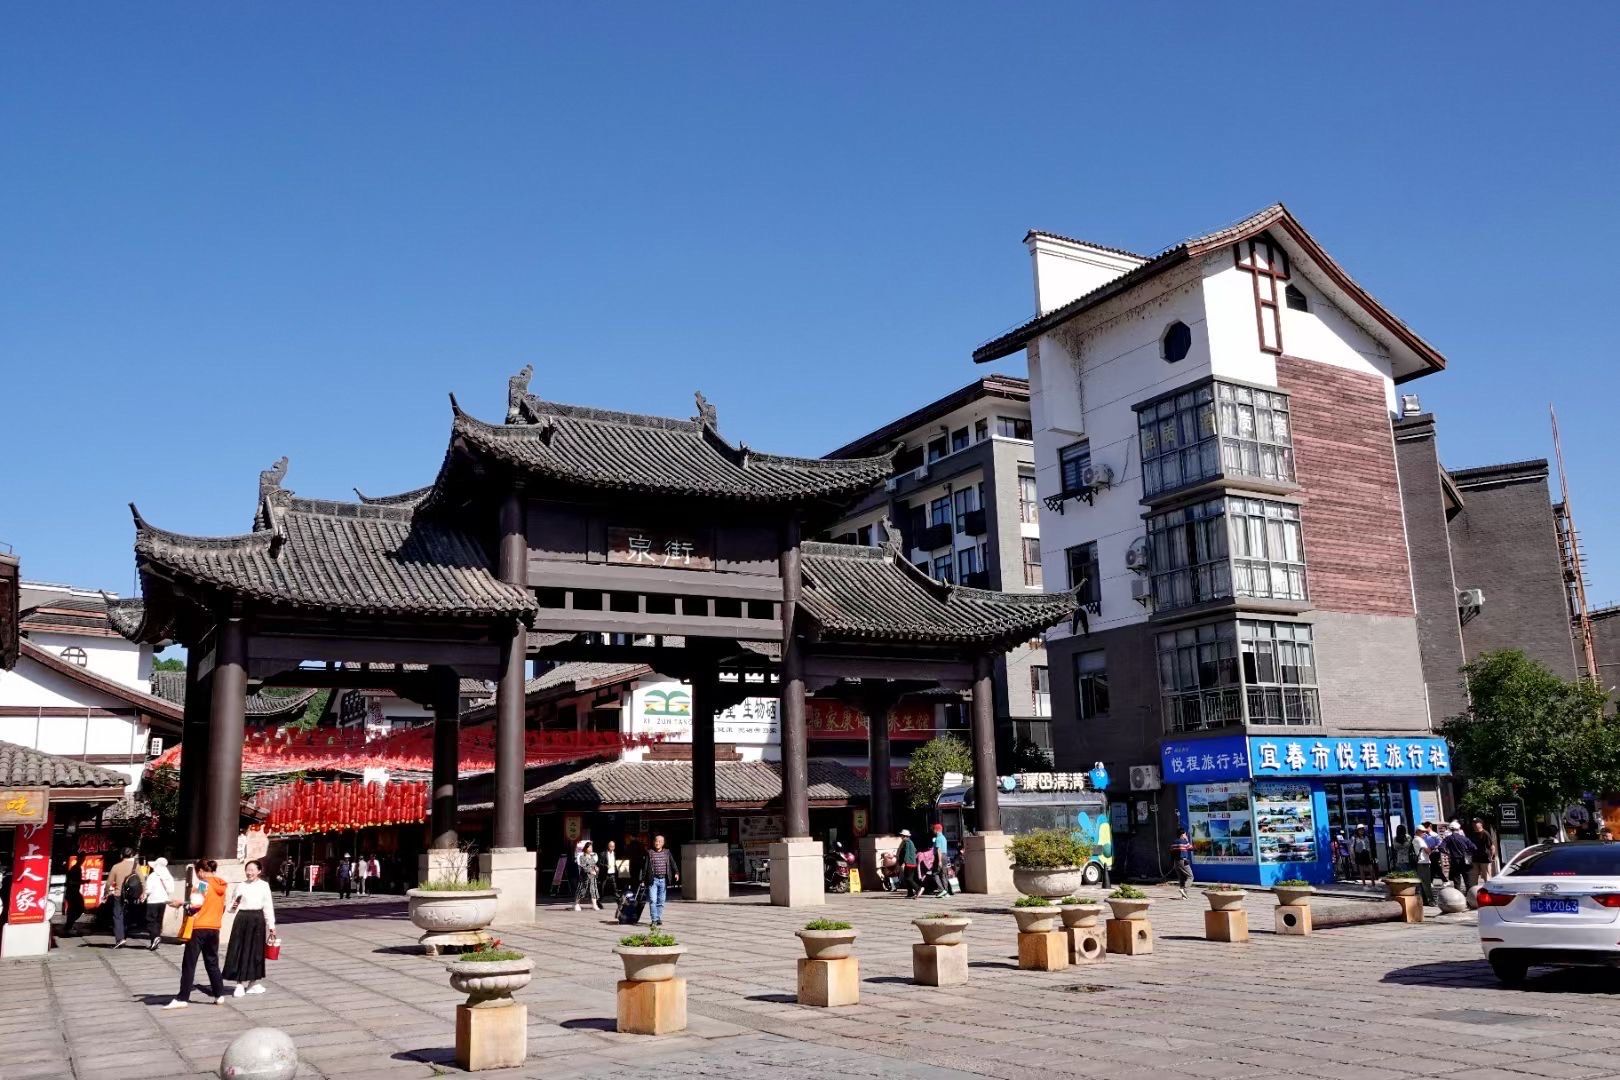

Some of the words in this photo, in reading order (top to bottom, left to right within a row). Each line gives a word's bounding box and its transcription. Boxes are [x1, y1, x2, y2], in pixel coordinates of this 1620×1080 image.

[1171, 752, 1247, 774] 悦程旅行社
[1259, 742, 1448, 771] 宜春市悦程旅行社
